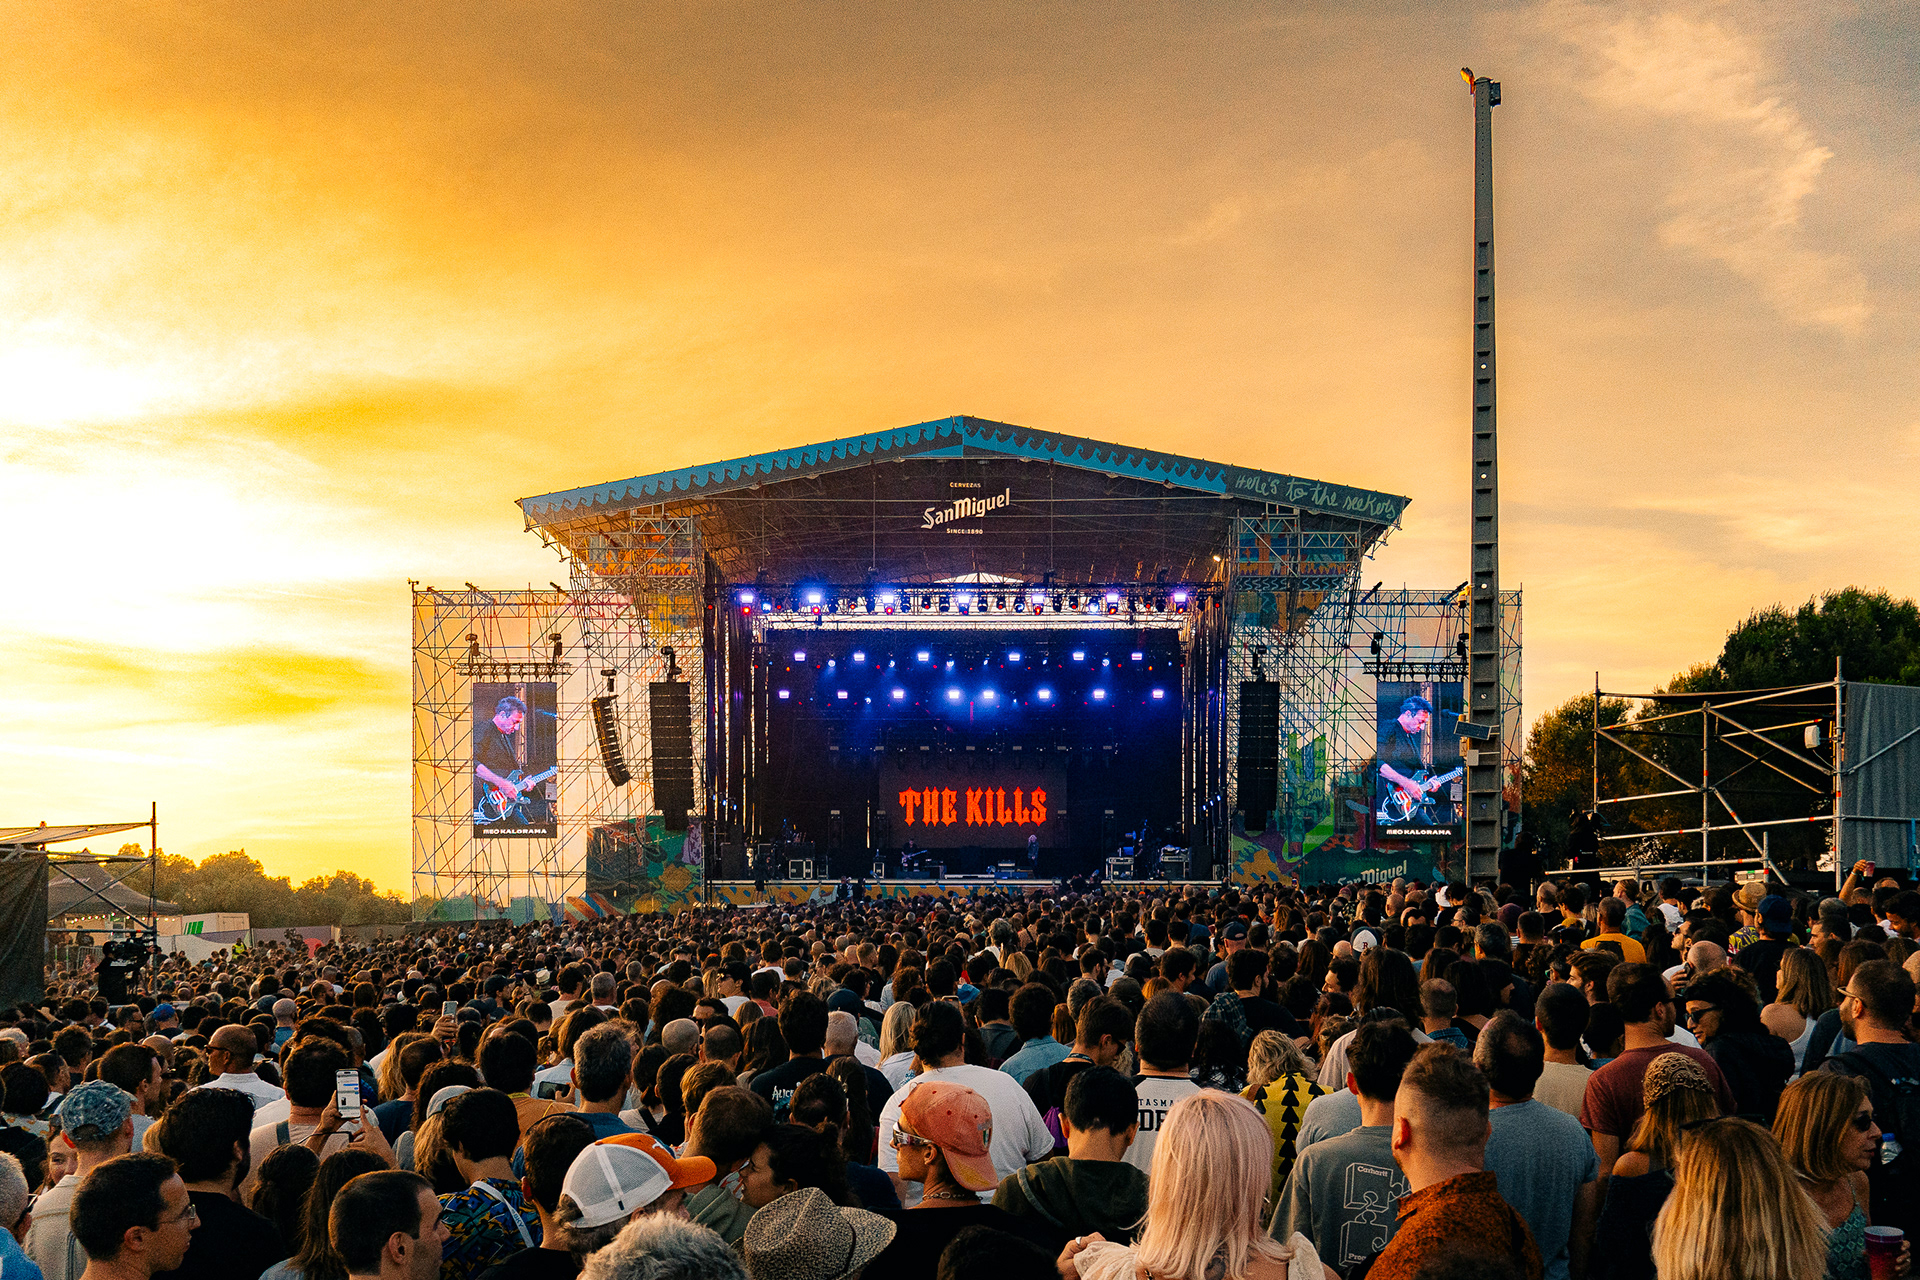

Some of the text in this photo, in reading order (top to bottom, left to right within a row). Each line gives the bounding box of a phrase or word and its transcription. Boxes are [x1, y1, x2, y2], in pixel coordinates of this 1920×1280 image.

[1285, 478, 1311, 502] to
[1310, 483, 1338, 507] the
[899, 786, 1048, 827] THE KILLS
